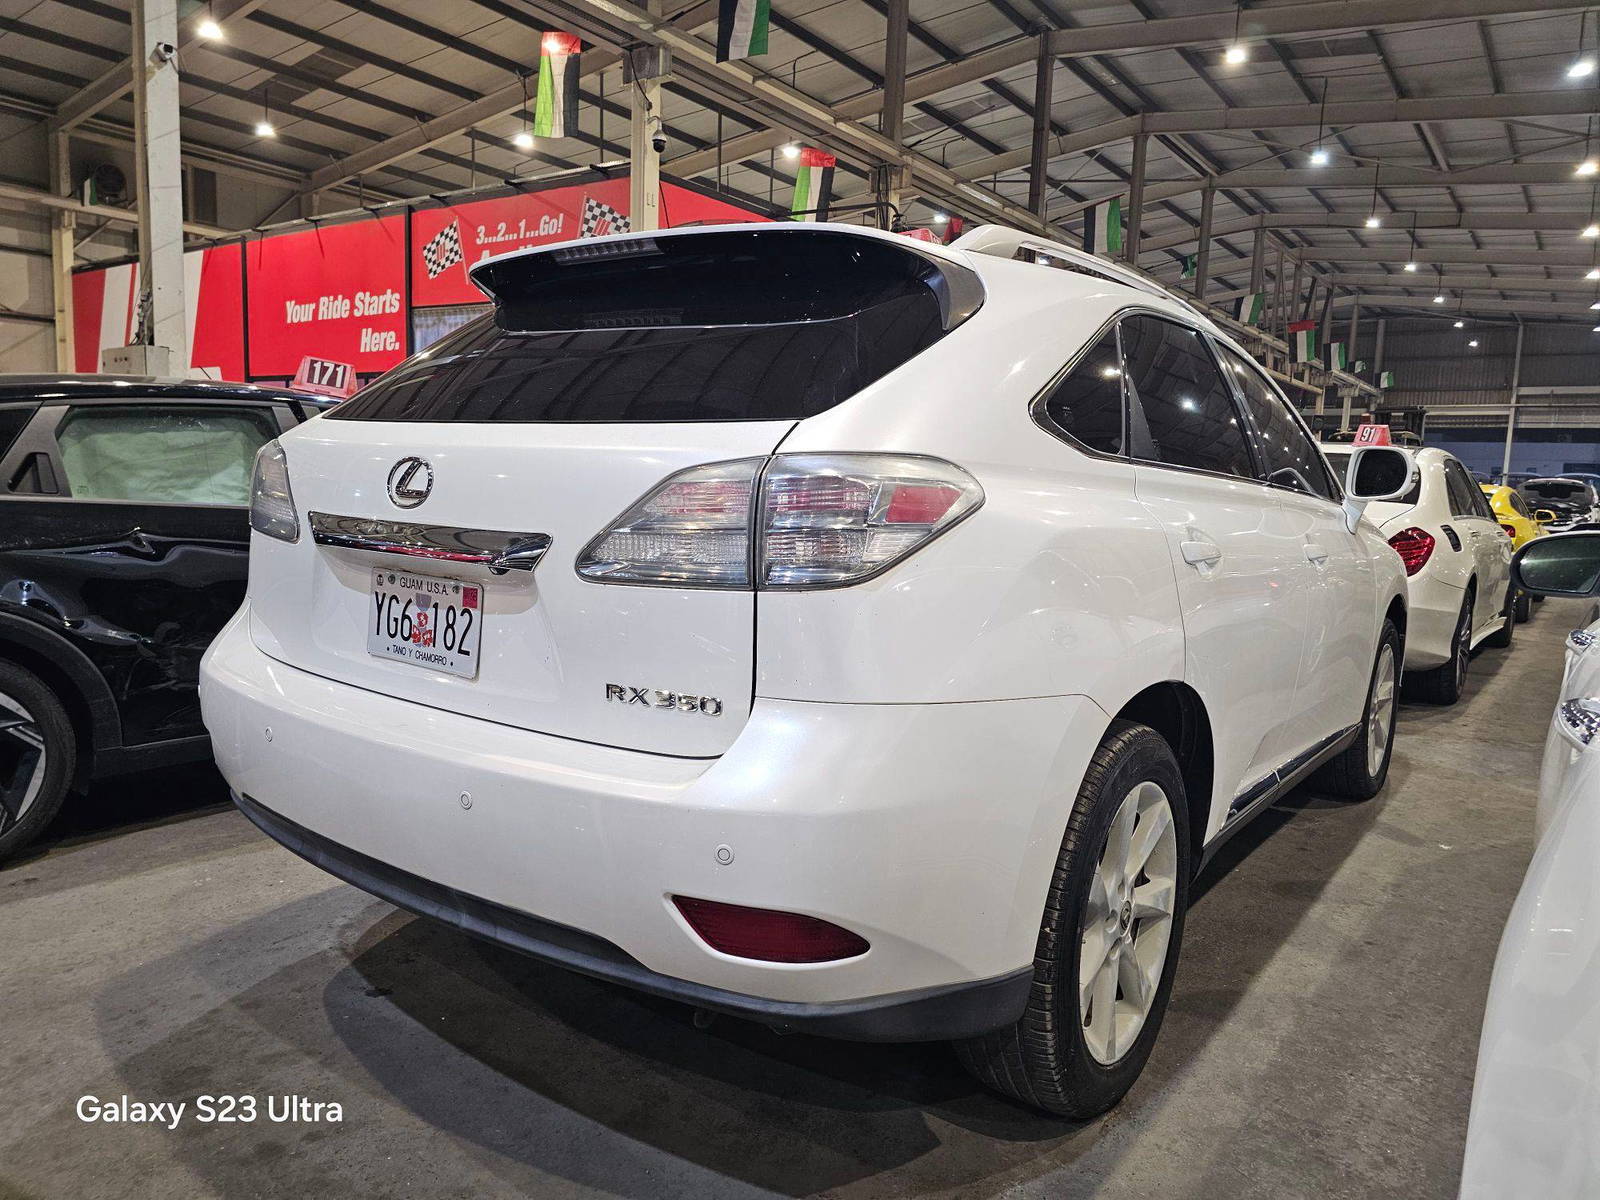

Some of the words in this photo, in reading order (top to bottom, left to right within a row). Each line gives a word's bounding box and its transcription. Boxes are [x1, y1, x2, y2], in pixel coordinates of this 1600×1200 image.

[286, 300, 316, 324] Your
[318, 295, 351, 320] Ride
[353, 289, 400, 317] Starts
[360, 328, 400, 352] Here.
[313, 361, 344, 388] 171
[1361, 427, 1376, 442] 91
[400, 576, 424, 592] GUAM
[606, 683, 650, 707] RX
[653, 689, 722, 716] 350
